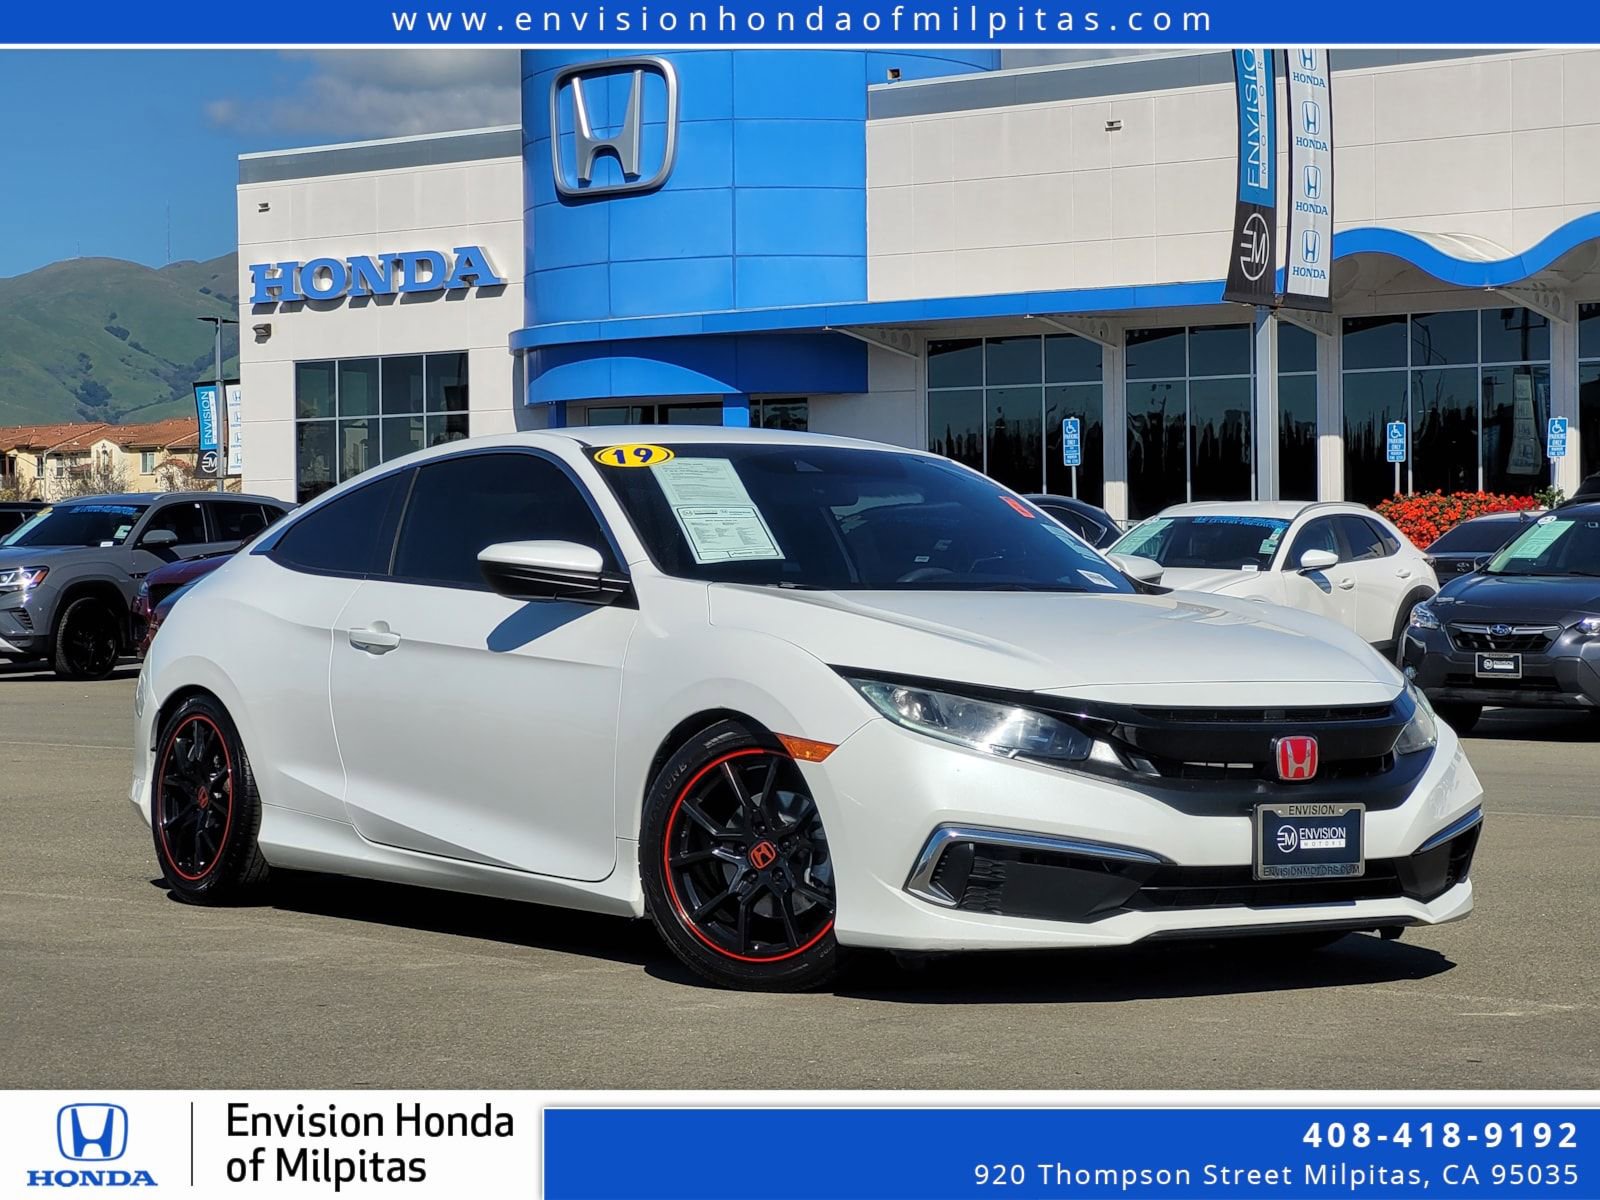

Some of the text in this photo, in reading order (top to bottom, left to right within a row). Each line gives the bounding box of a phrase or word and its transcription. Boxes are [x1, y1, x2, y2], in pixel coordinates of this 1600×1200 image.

[1293, 71, 1326, 88] HONDA
[1296, 136, 1328, 152] HONDA
[1296, 201, 1328, 216] HONDA
[249, 246, 502, 304] HONDA
[1293, 266, 1326, 280] HONDA
[201, 391, 213, 445] ENVISION
[612, 448, 653, 464] 19
[1288, 805, 1336, 815] ENVISION
[1299, 827, 1346, 840] ENVISION
[1263, 864, 1360, 877] ENVISIONMOTORS.COM
